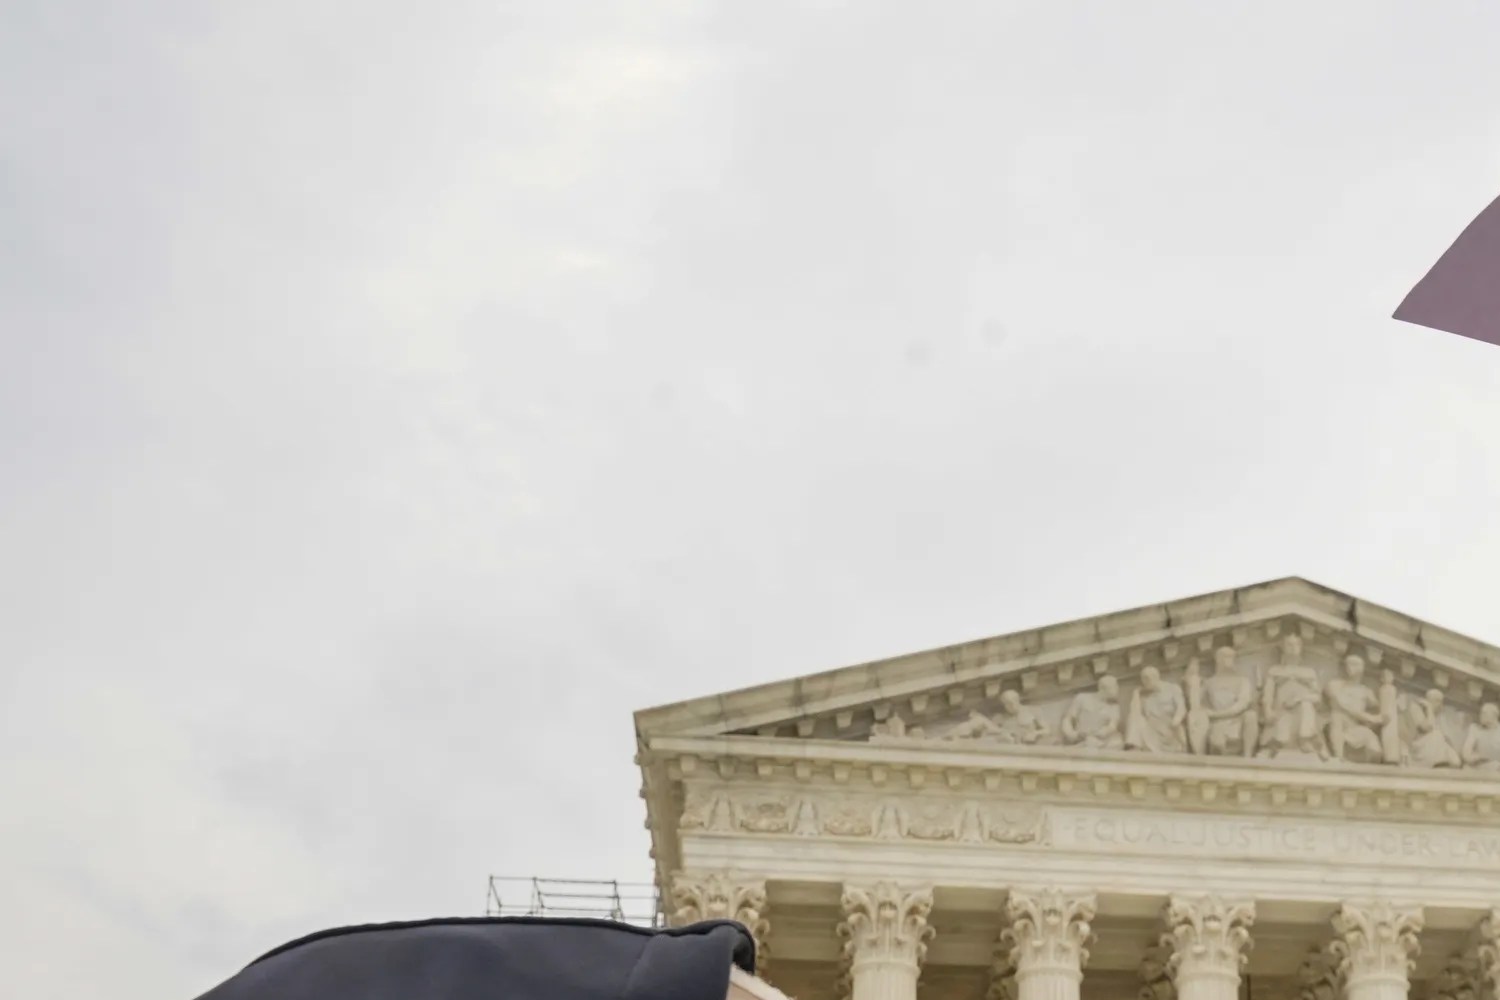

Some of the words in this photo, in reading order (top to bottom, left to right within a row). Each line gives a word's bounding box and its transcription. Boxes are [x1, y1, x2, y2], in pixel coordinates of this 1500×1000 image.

[1074, 816, 1186, 846] EQUAL
[1191, 819, 1316, 853] JUSTICE
[1332, 829, 1440, 858] UNDER
